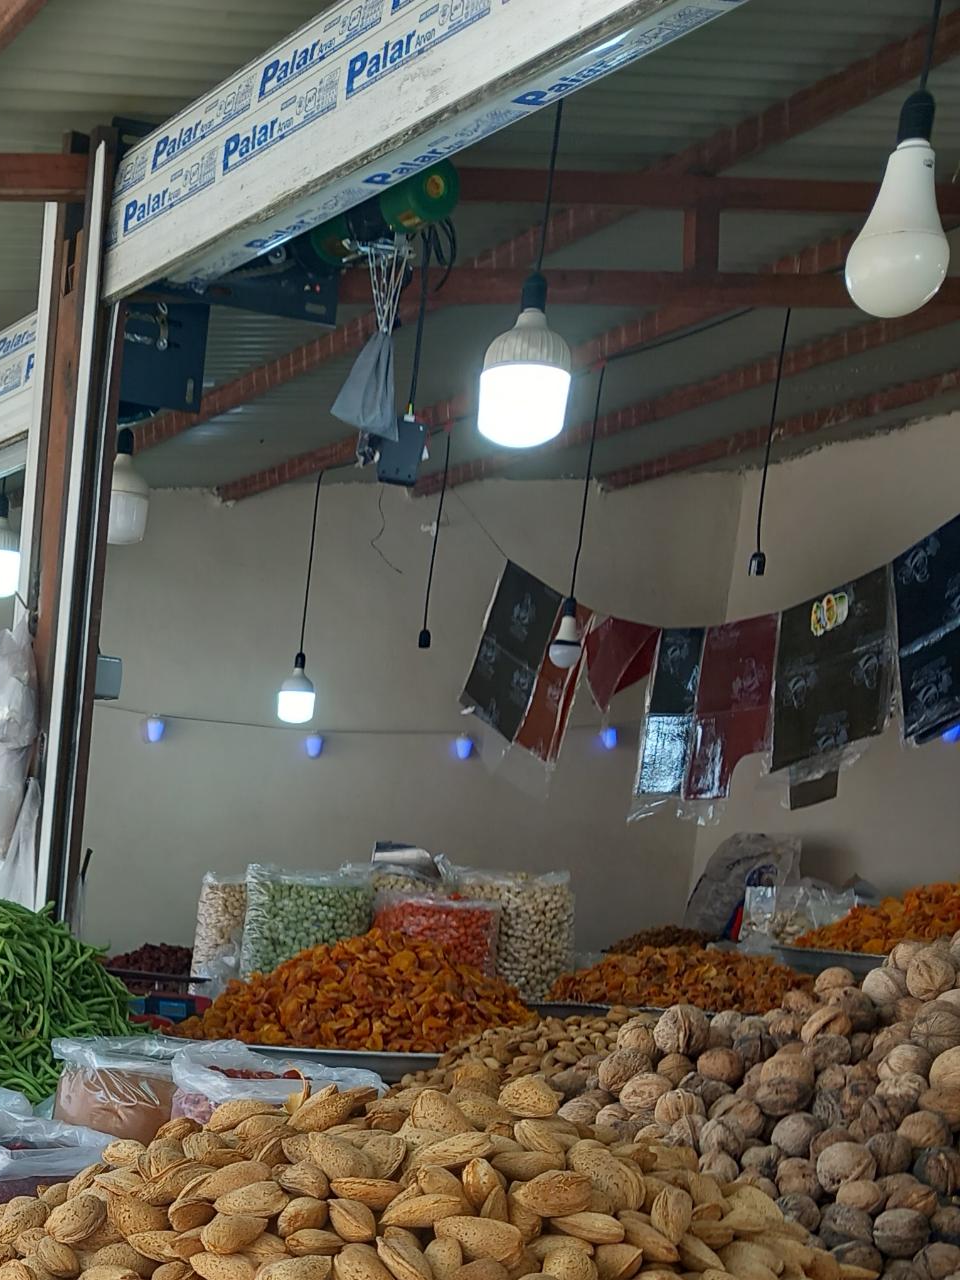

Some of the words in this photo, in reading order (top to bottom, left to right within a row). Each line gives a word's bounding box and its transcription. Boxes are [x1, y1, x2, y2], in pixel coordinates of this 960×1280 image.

[124, 188, 168, 236] Palar
[223, 118, 278, 175] Palar
[277, 117, 293, 133] Arvan
[346, 30, 416, 98] Palar
[415, 28, 435, 48] Arvan
[152, 120, 201, 173] Palar
[258, 40, 320, 102] Palar
[318, 38, 335, 54] Arvan
[363, 148, 443, 184] Palar
[511, 60, 611, 105] Palar
